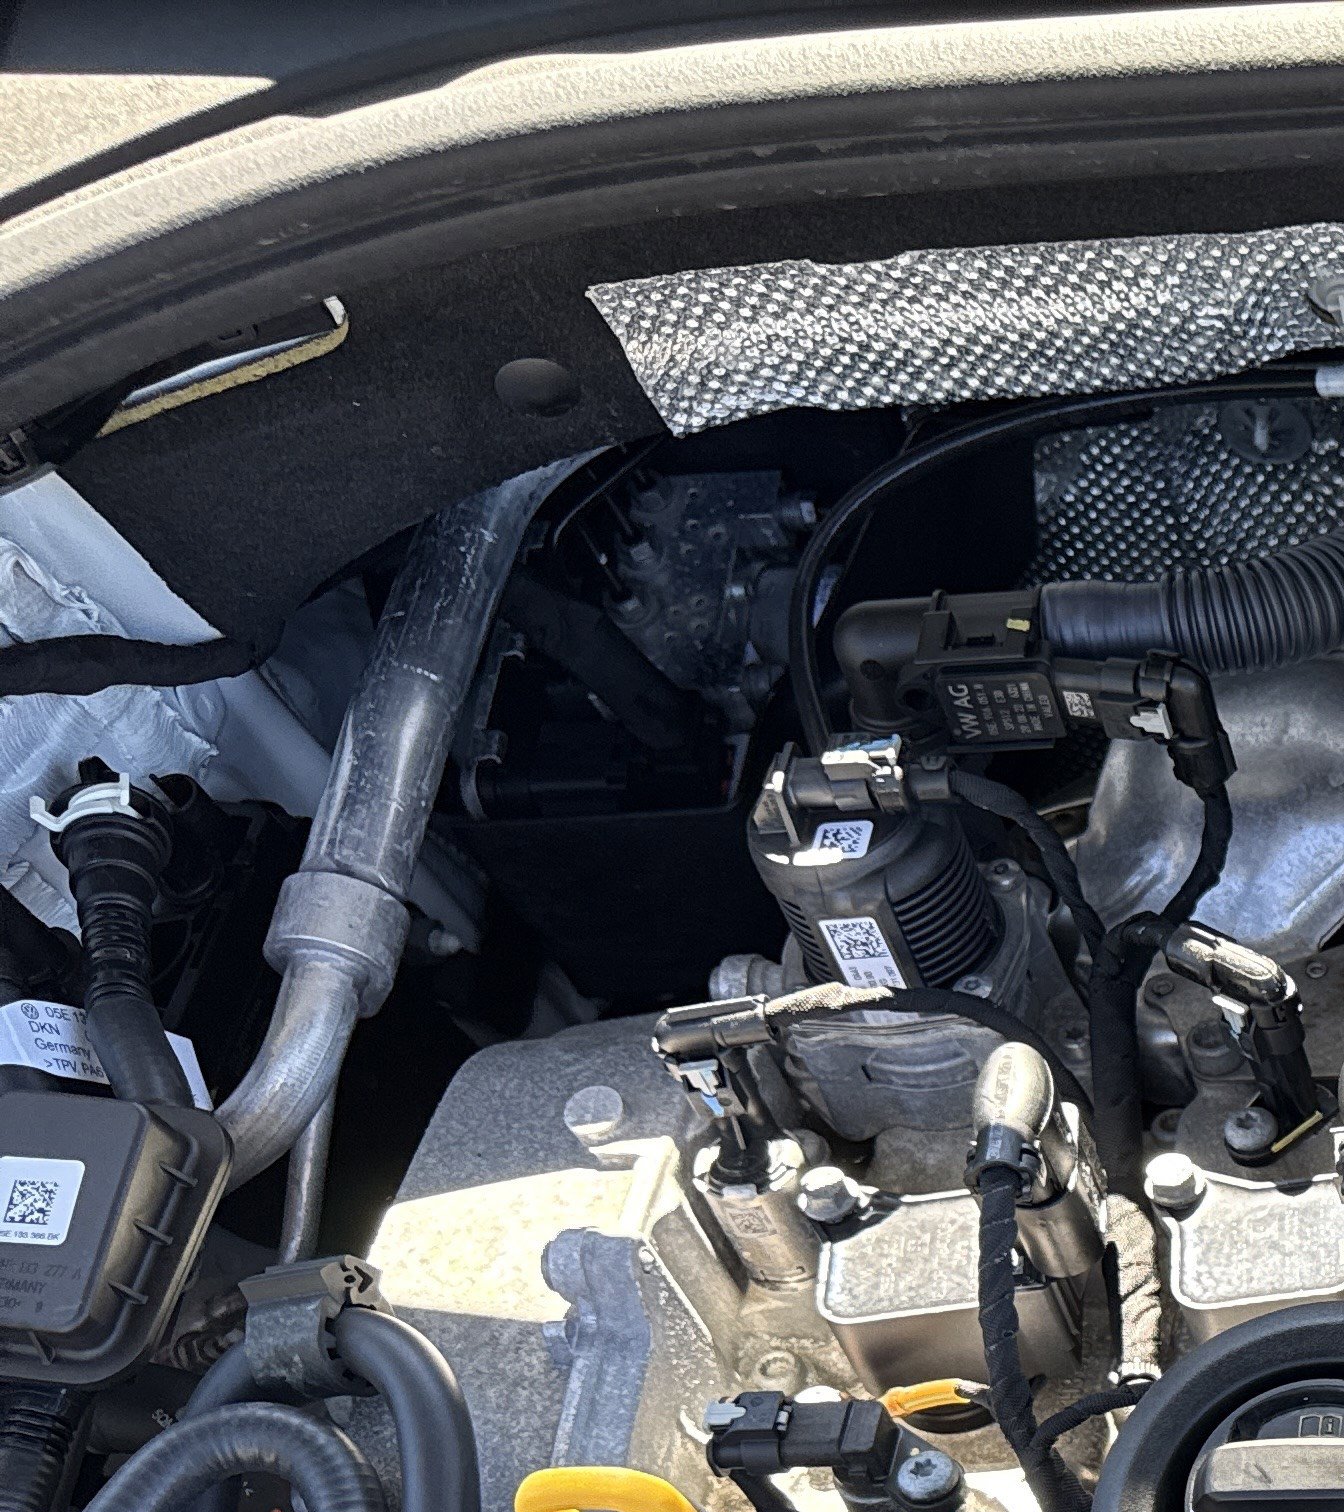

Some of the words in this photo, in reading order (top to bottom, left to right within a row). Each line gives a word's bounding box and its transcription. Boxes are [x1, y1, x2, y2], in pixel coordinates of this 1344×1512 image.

[948, 683, 973, 708] AG
[957, 712, 981, 738] VW
[45, 1007, 70, 1021] 05E
[73, 1011, 88, 1024] 13
[28, 1020, 60, 1035] DKN
[34, 1037, 90, 1060] Germany
[0, 1277, 45, 1293] ERMANY
